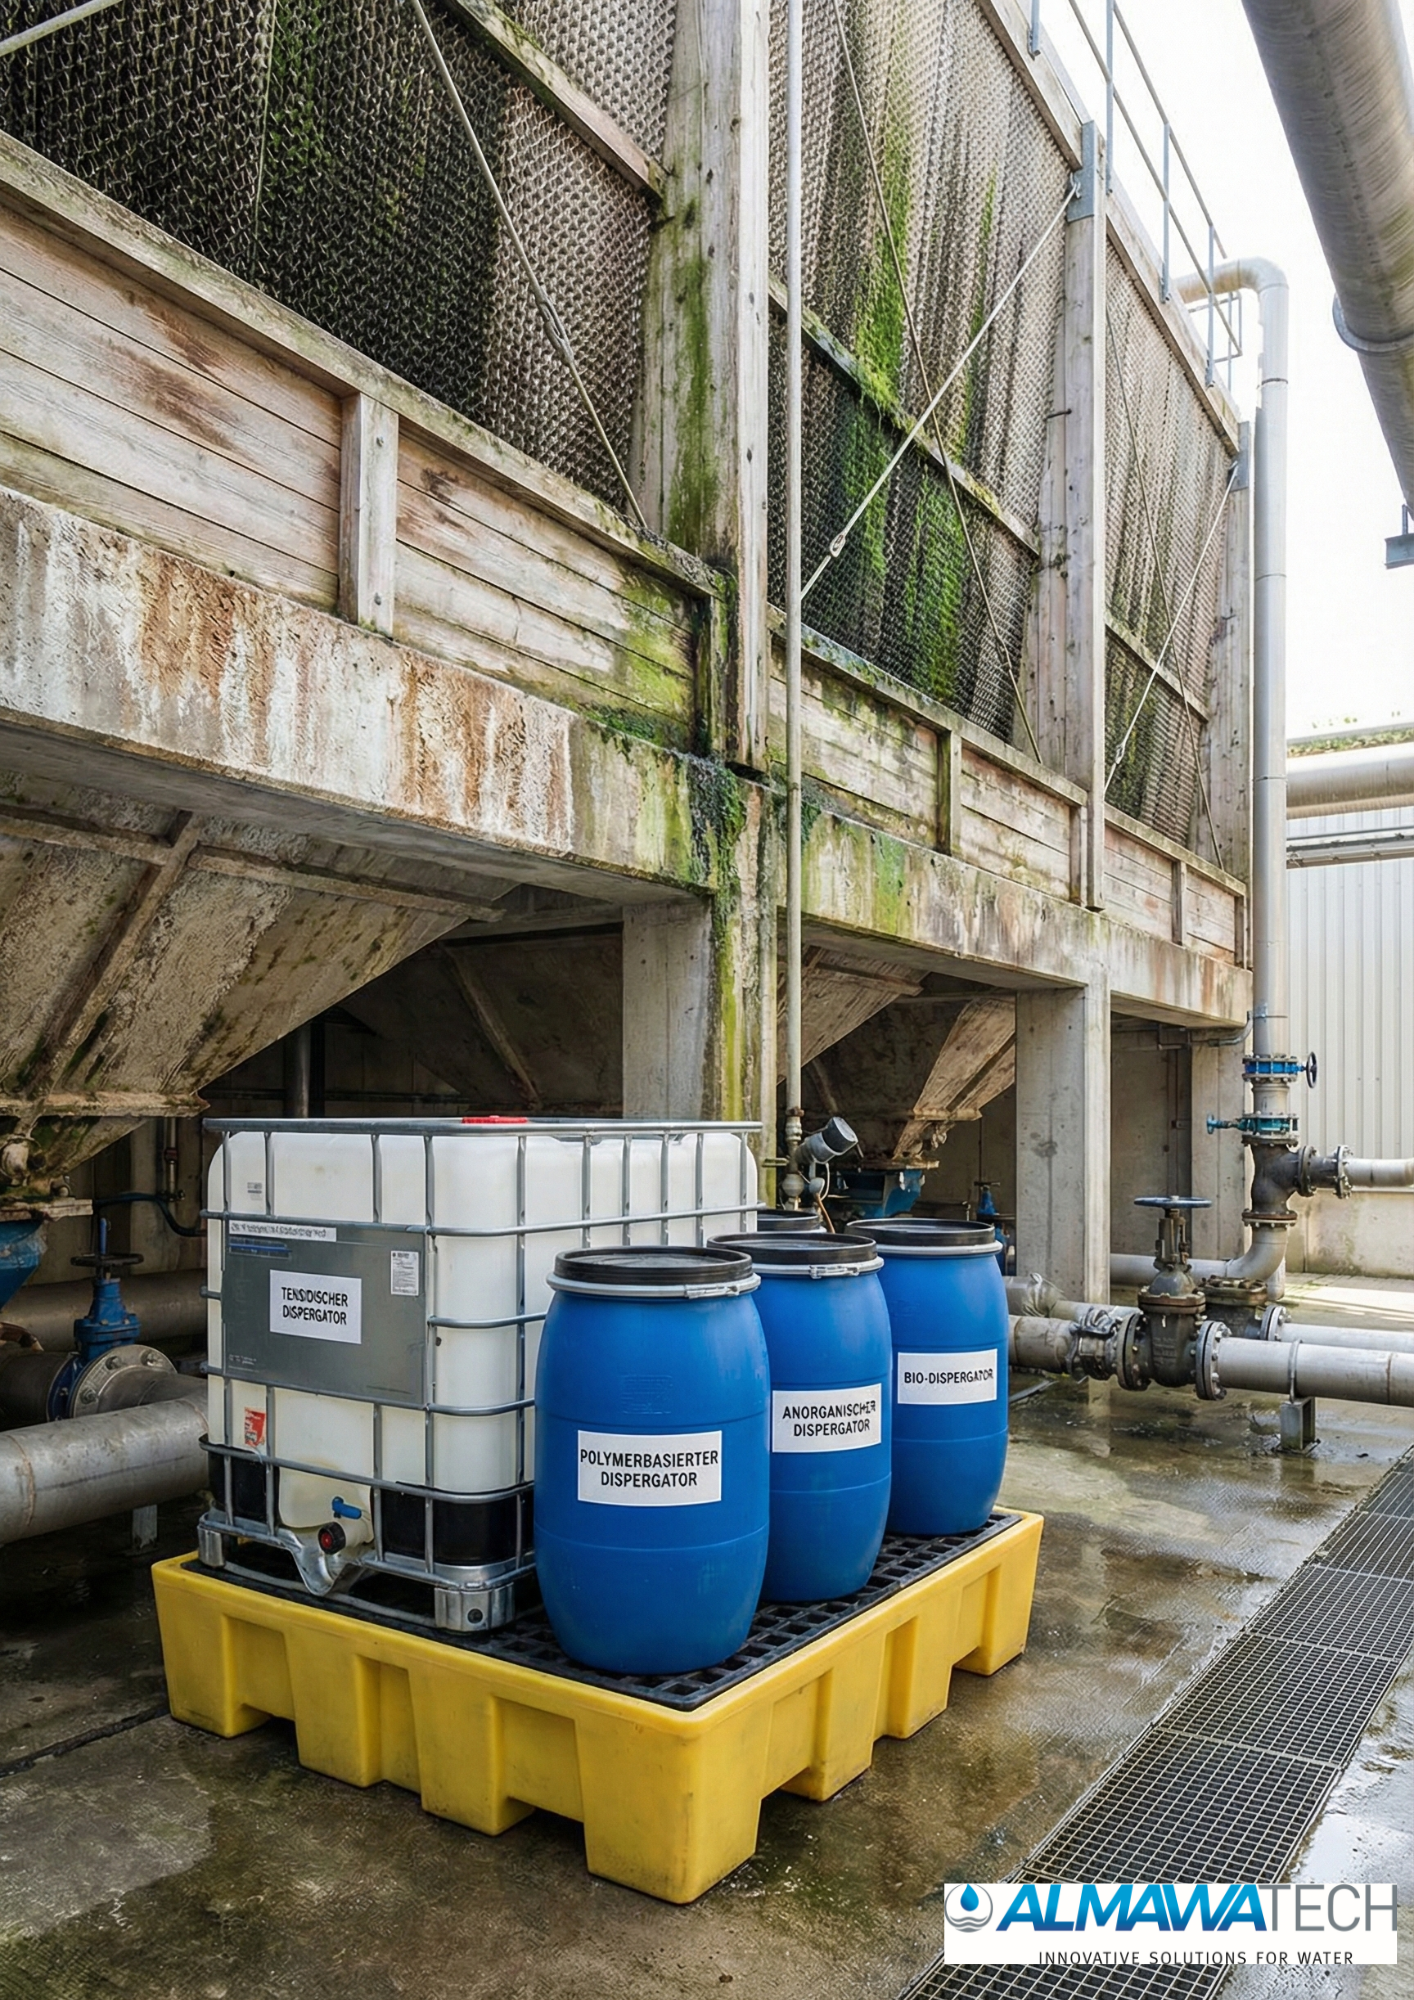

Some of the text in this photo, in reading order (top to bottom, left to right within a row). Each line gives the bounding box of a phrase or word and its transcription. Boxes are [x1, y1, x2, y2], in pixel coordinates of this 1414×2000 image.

[282, 1304, 347, 1325] DISPERGATOR
[904, 1368, 994, 1384] BIO-DISPERGATOR
[793, 1418, 870, 1437] DISPERGATOR
[580, 1449, 719, 1468] POLYMERBASIERTER
[601, 1471, 698, 1488] DISPERGATOR
